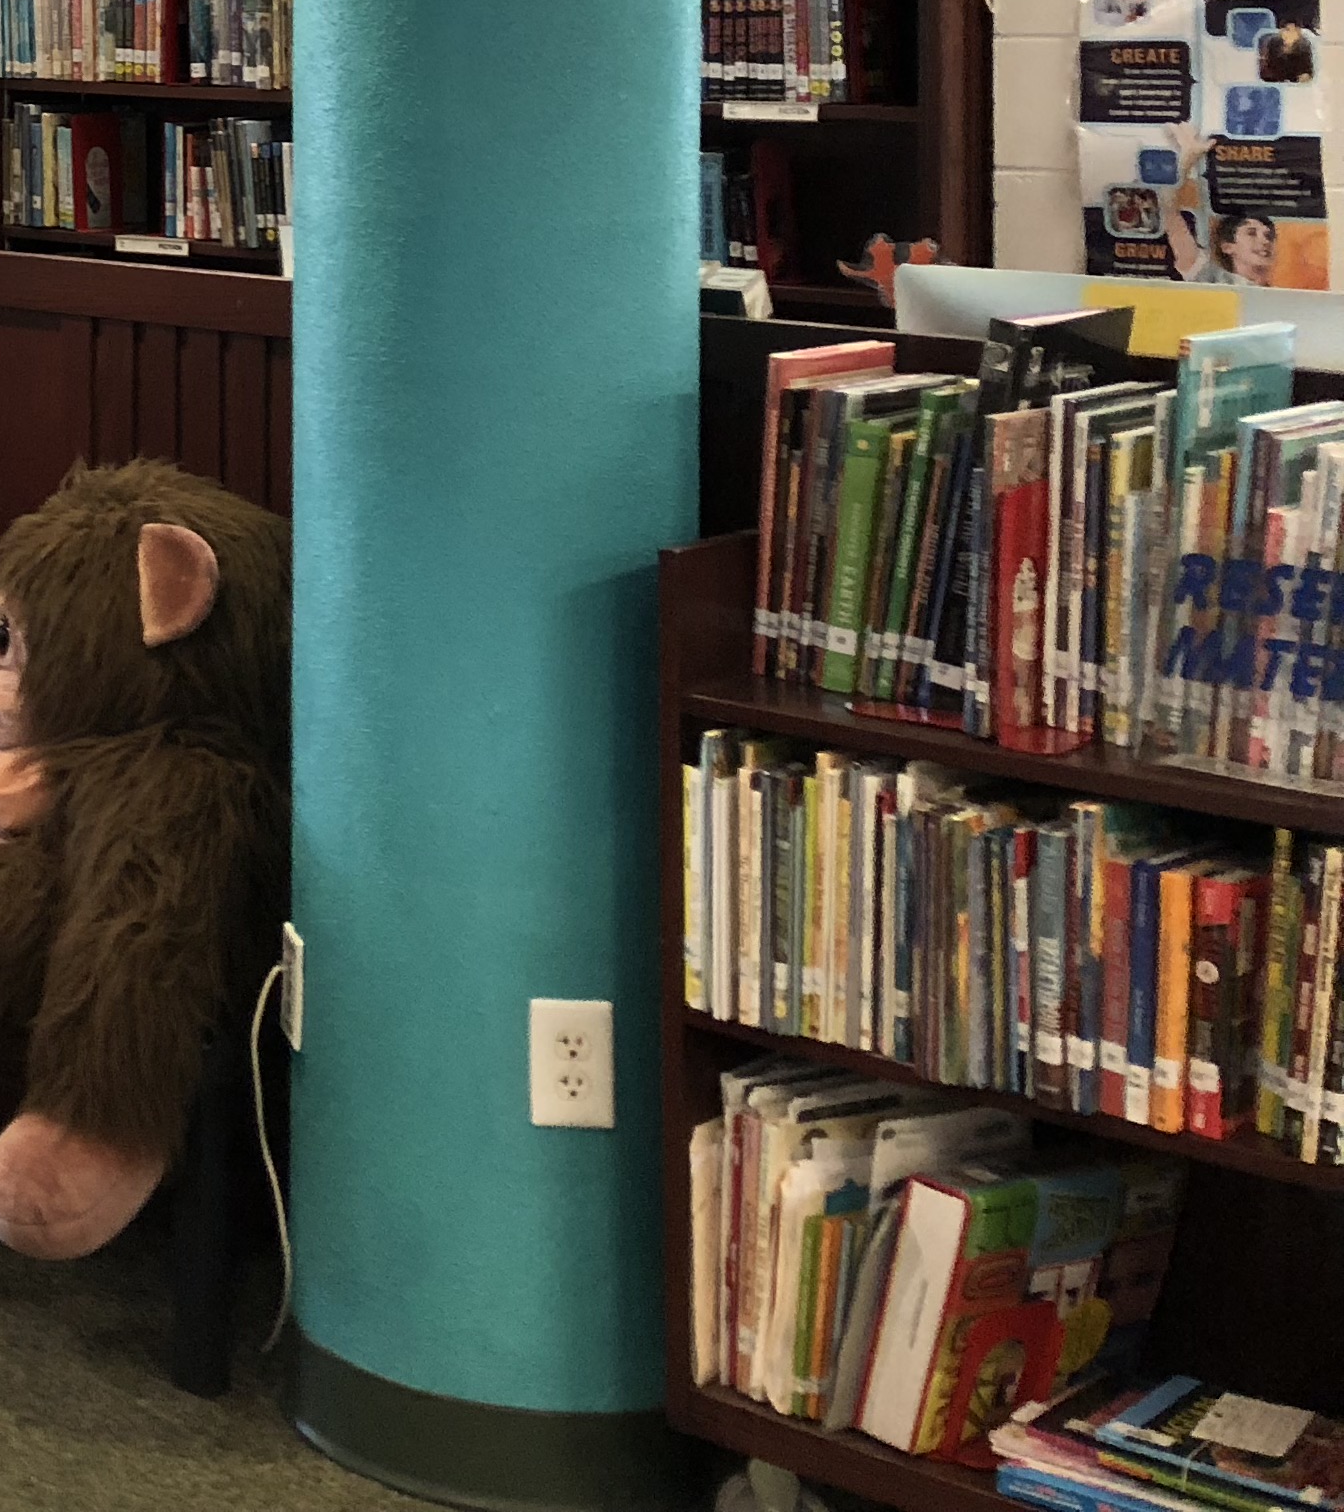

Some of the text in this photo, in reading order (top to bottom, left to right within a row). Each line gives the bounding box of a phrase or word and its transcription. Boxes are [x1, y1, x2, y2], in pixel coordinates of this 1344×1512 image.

[830, 20, 844, 62] LOO
[1111, 47, 1181, 65] CREATE
[1215, 145, 1276, 163] SHARE
[1114, 242, 1167, 260] GROW
